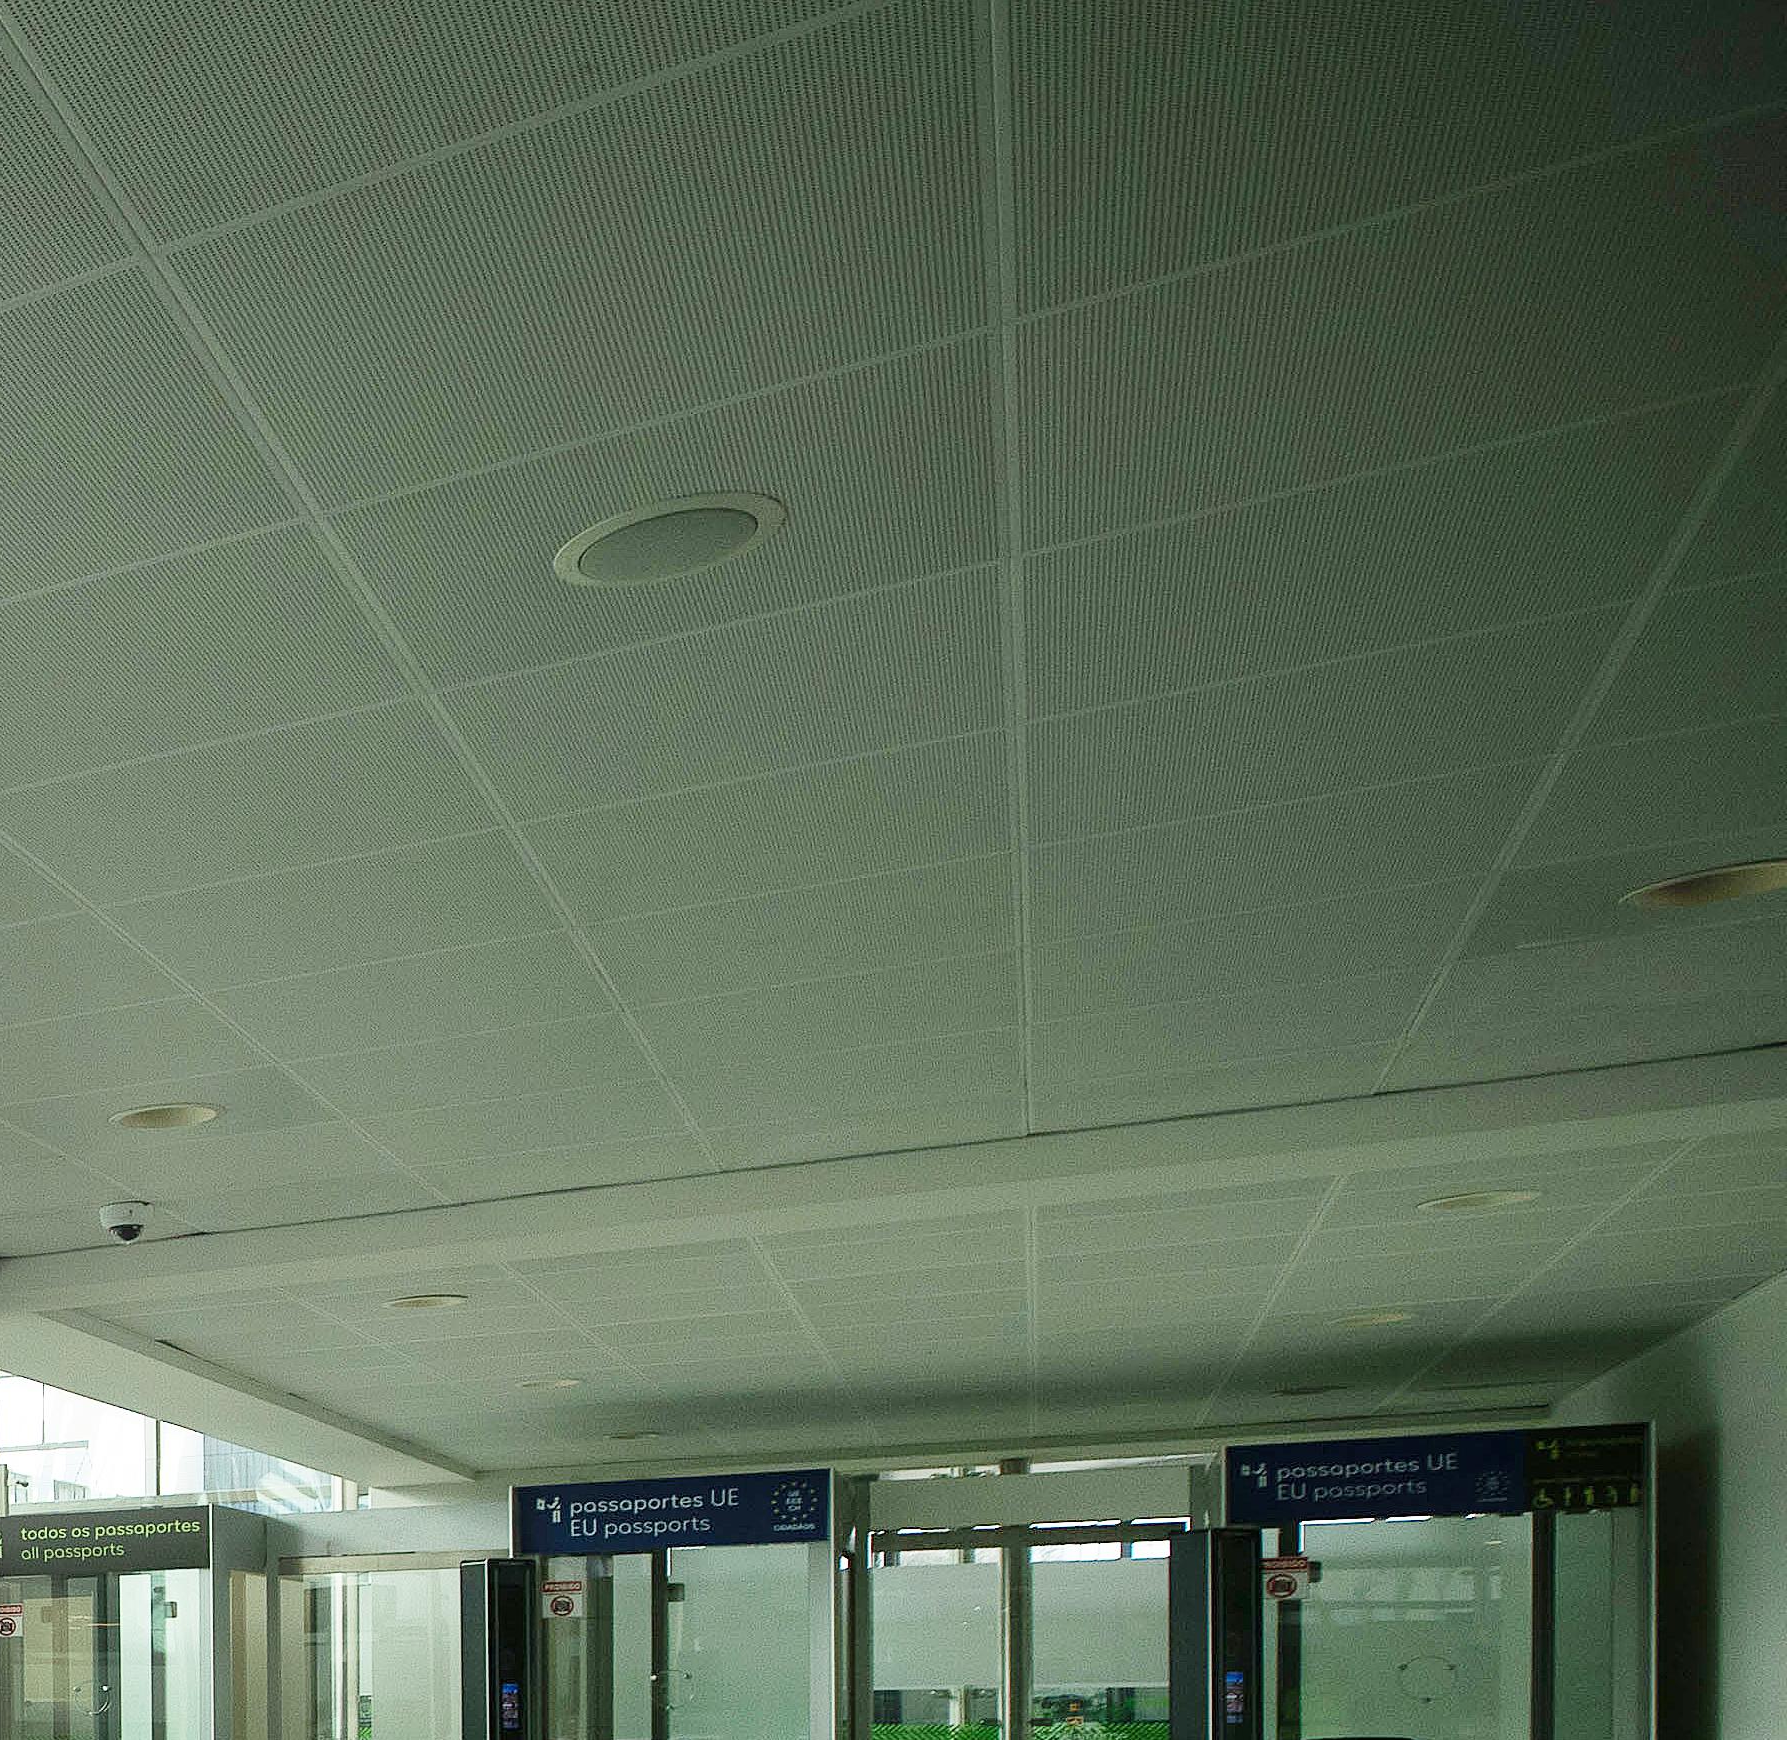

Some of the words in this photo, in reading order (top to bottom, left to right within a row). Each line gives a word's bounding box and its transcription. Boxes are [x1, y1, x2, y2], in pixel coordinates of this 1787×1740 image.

[1274, 1457, 1421, 1483] passaportes
[1427, 1452, 1460, 1473] UE
[1275, 1481, 1307, 1502] EU
[1313, 1477, 1429, 1503] passports
[570, 1492, 704, 1518] passaportes
[711, 1488, 740, 1507] UE
[20, 1527, 67, 1541] todos
[71, 1526, 91, 1538] os
[95, 1519, 201, 1541] passaportes
[570, 1518, 597, 1538] EU
[604, 1517, 712, 1539] passports
[21, 1546, 39, 1561] all
[43, 1543, 125, 1563] passports
